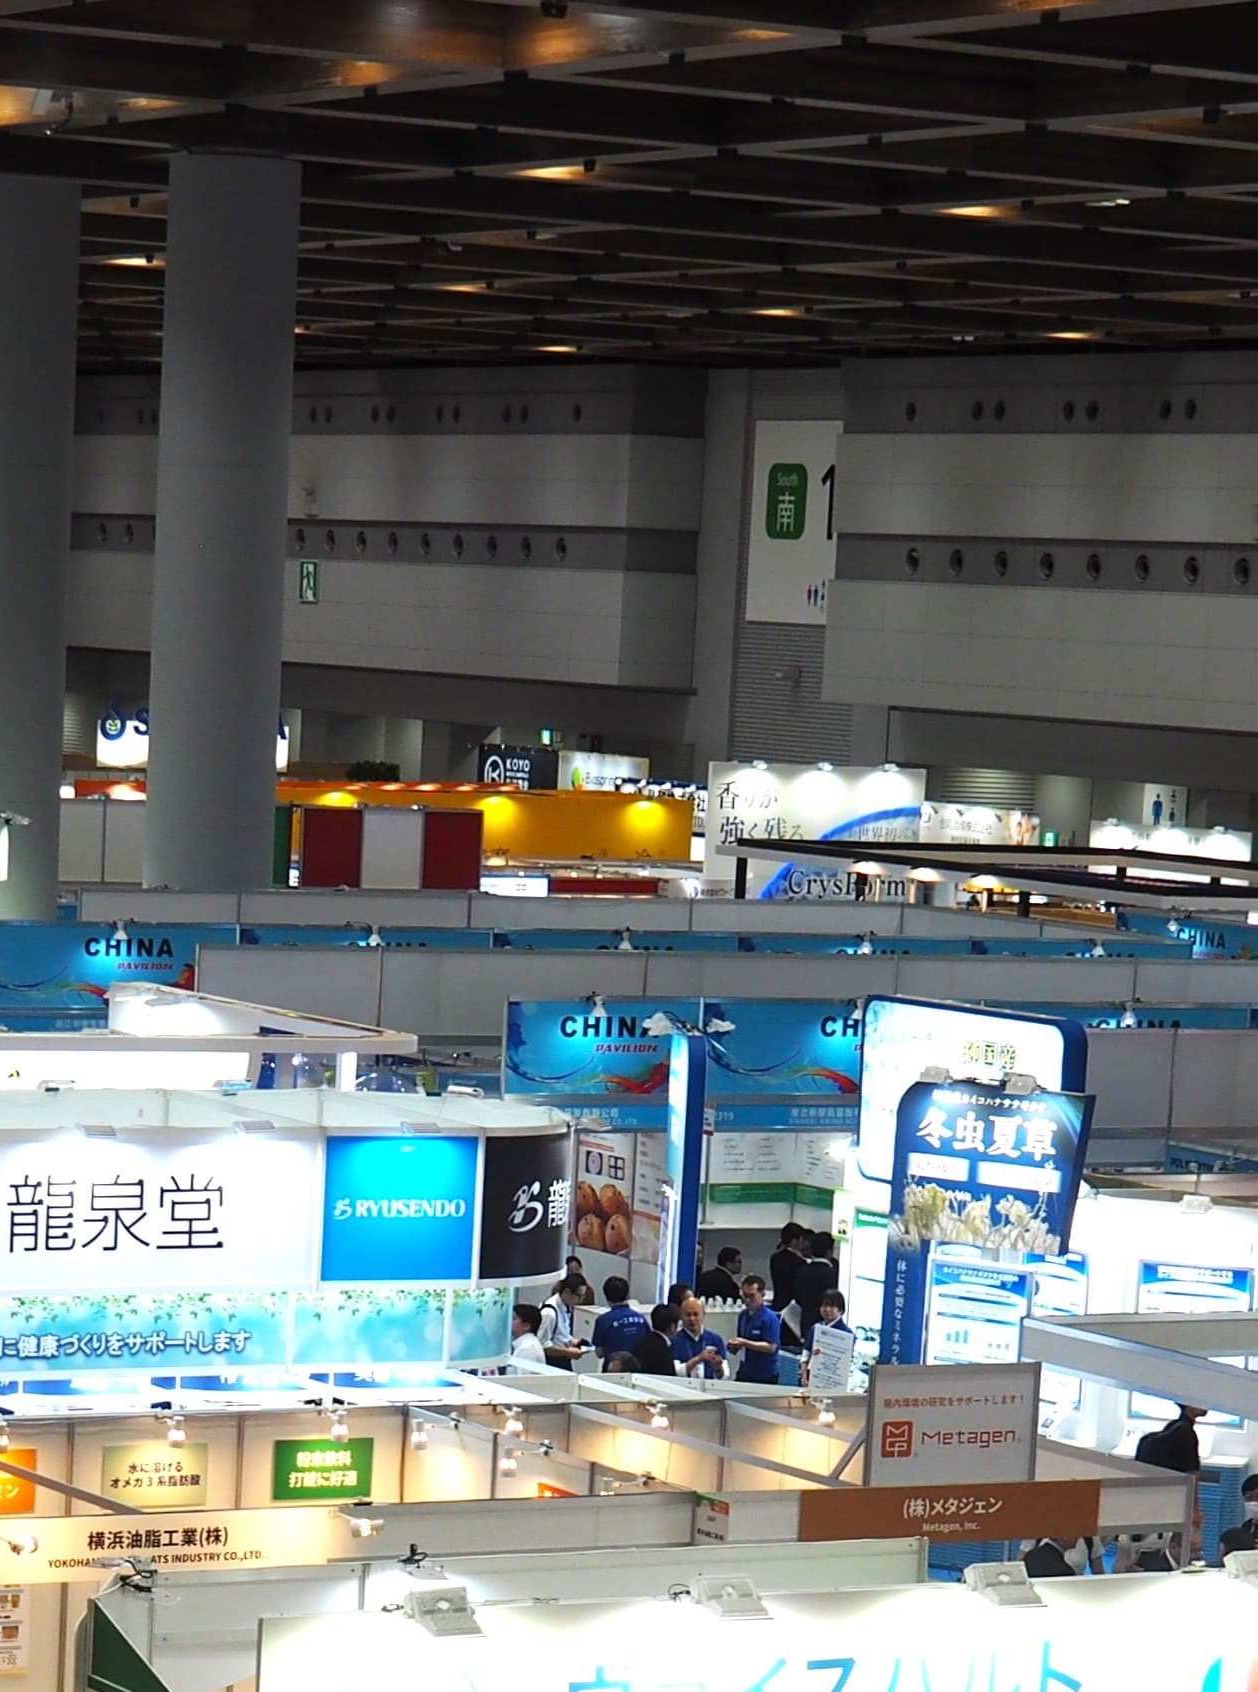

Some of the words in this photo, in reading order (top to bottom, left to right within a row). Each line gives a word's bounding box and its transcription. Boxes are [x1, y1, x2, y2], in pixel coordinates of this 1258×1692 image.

[776, 472, 799, 488] South
[775, 490, 796, 532] 南
[505, 758, 532, 773] KOYO
[84, 937, 174, 958] CHINA
[117, 962, 173, 971] PAVILION
[595, 1043, 658, 1053] PAVILION
[915, 1106, 1059, 1162] 冬虫夏草
[5, 1172, 225, 1253] 龍泉堂
[355, 1198, 466, 1220] RYUSENDO
[920, 1429, 1017, 1448] Metagen
[902, 1496, 1004, 1520] (株)メタジェン
[86, 1526, 229, 1551] 横浜油脂工業(株)
[170, 1553, 222, 1565] INDUSTRY
